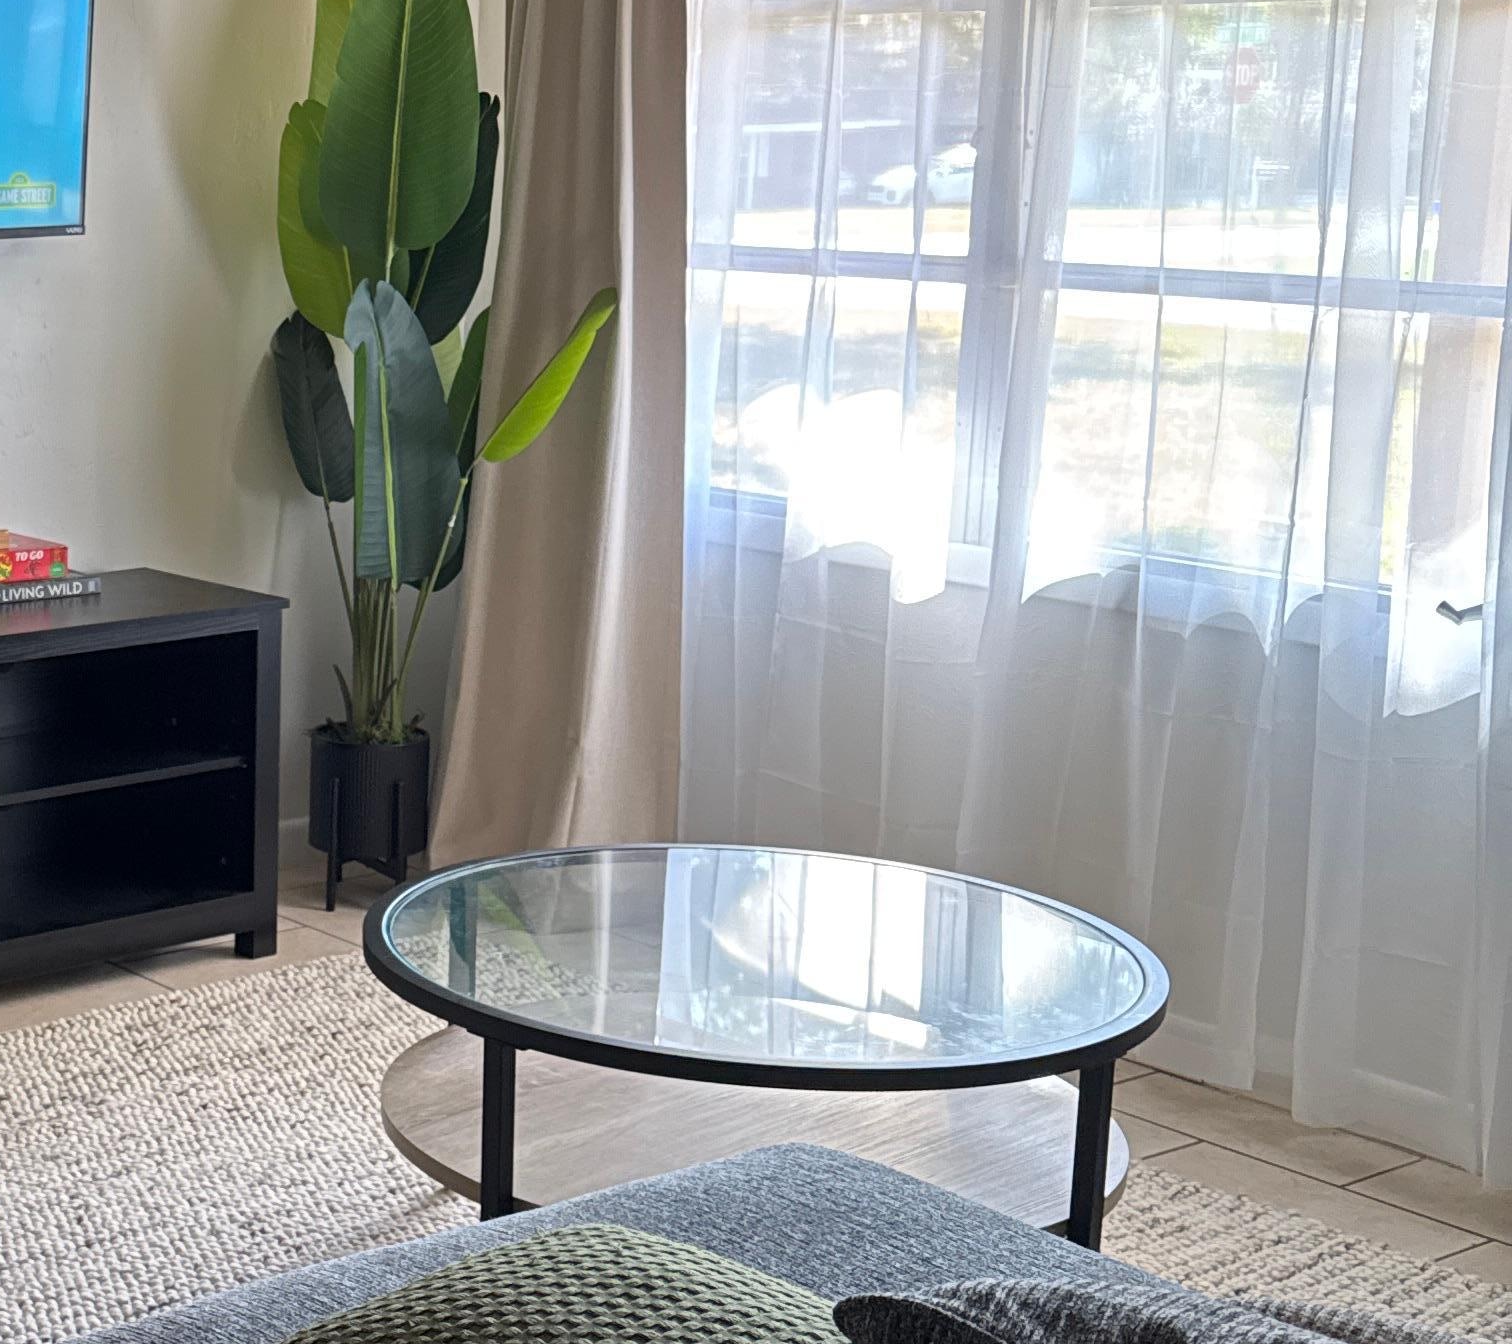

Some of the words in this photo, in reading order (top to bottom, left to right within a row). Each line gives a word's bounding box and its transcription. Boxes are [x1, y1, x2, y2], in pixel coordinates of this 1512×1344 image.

[21, 187, 52, 203] STREET
[15, 551, 28, 562] TO
[29, 550, 44, 561] GO
[2, 585, 44, 602] LIVING
[47, 581, 83, 596] WILD
